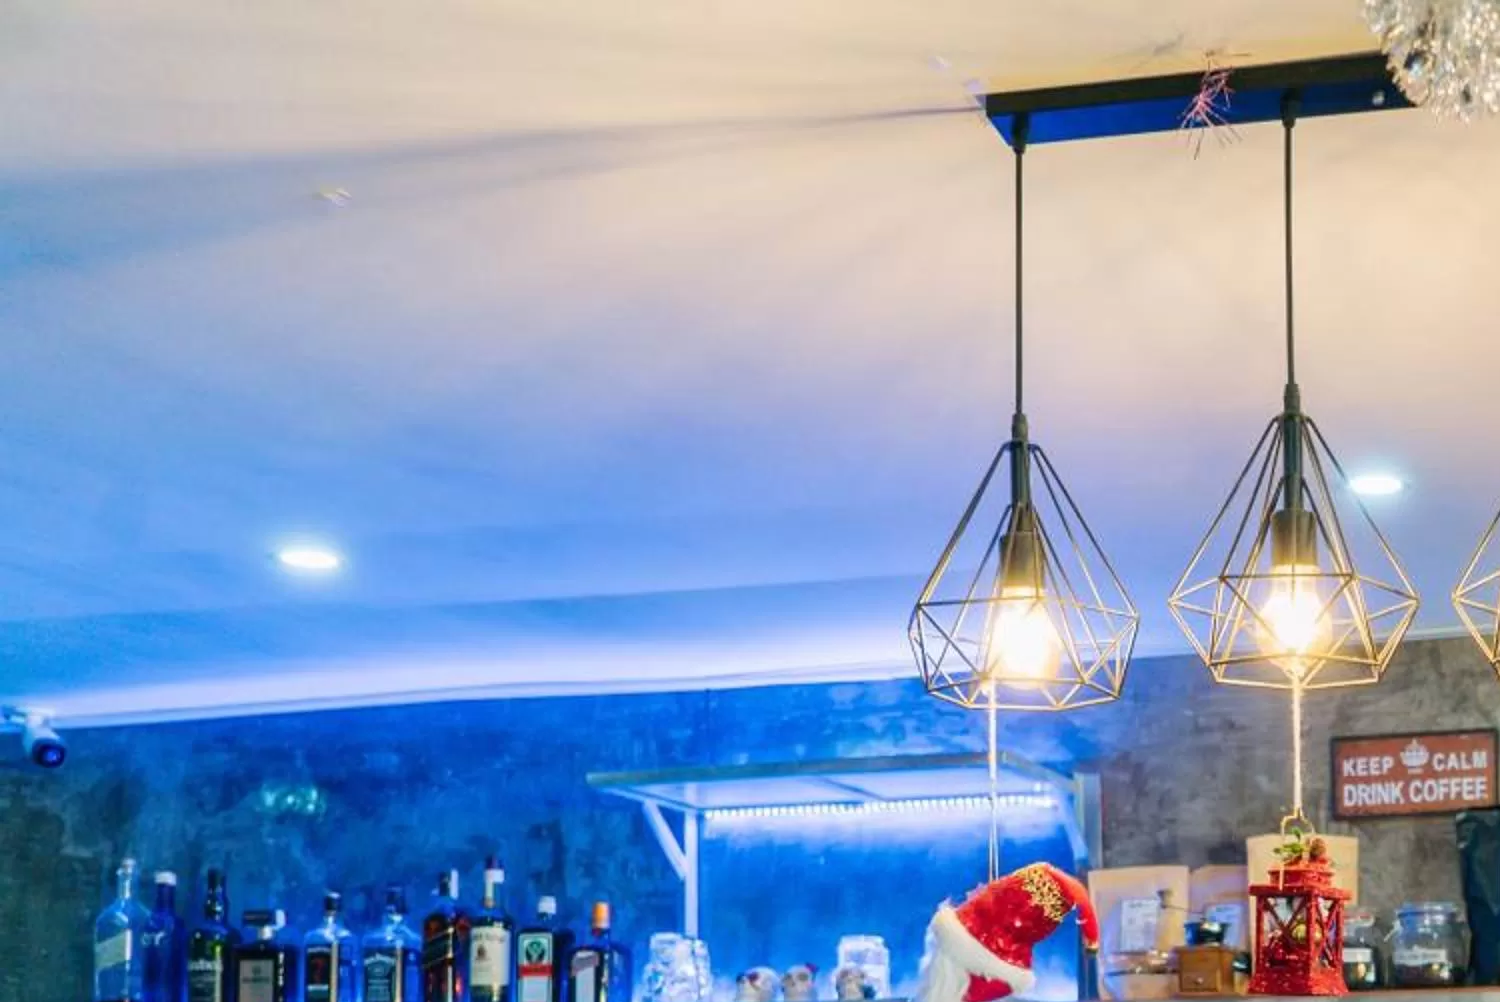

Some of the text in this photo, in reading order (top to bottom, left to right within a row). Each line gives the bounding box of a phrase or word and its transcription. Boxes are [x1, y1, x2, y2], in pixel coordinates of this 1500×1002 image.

[1343, 748, 1488, 777] KEEP CALM
[1343, 775, 1488, 807] DRINK COFFEE
